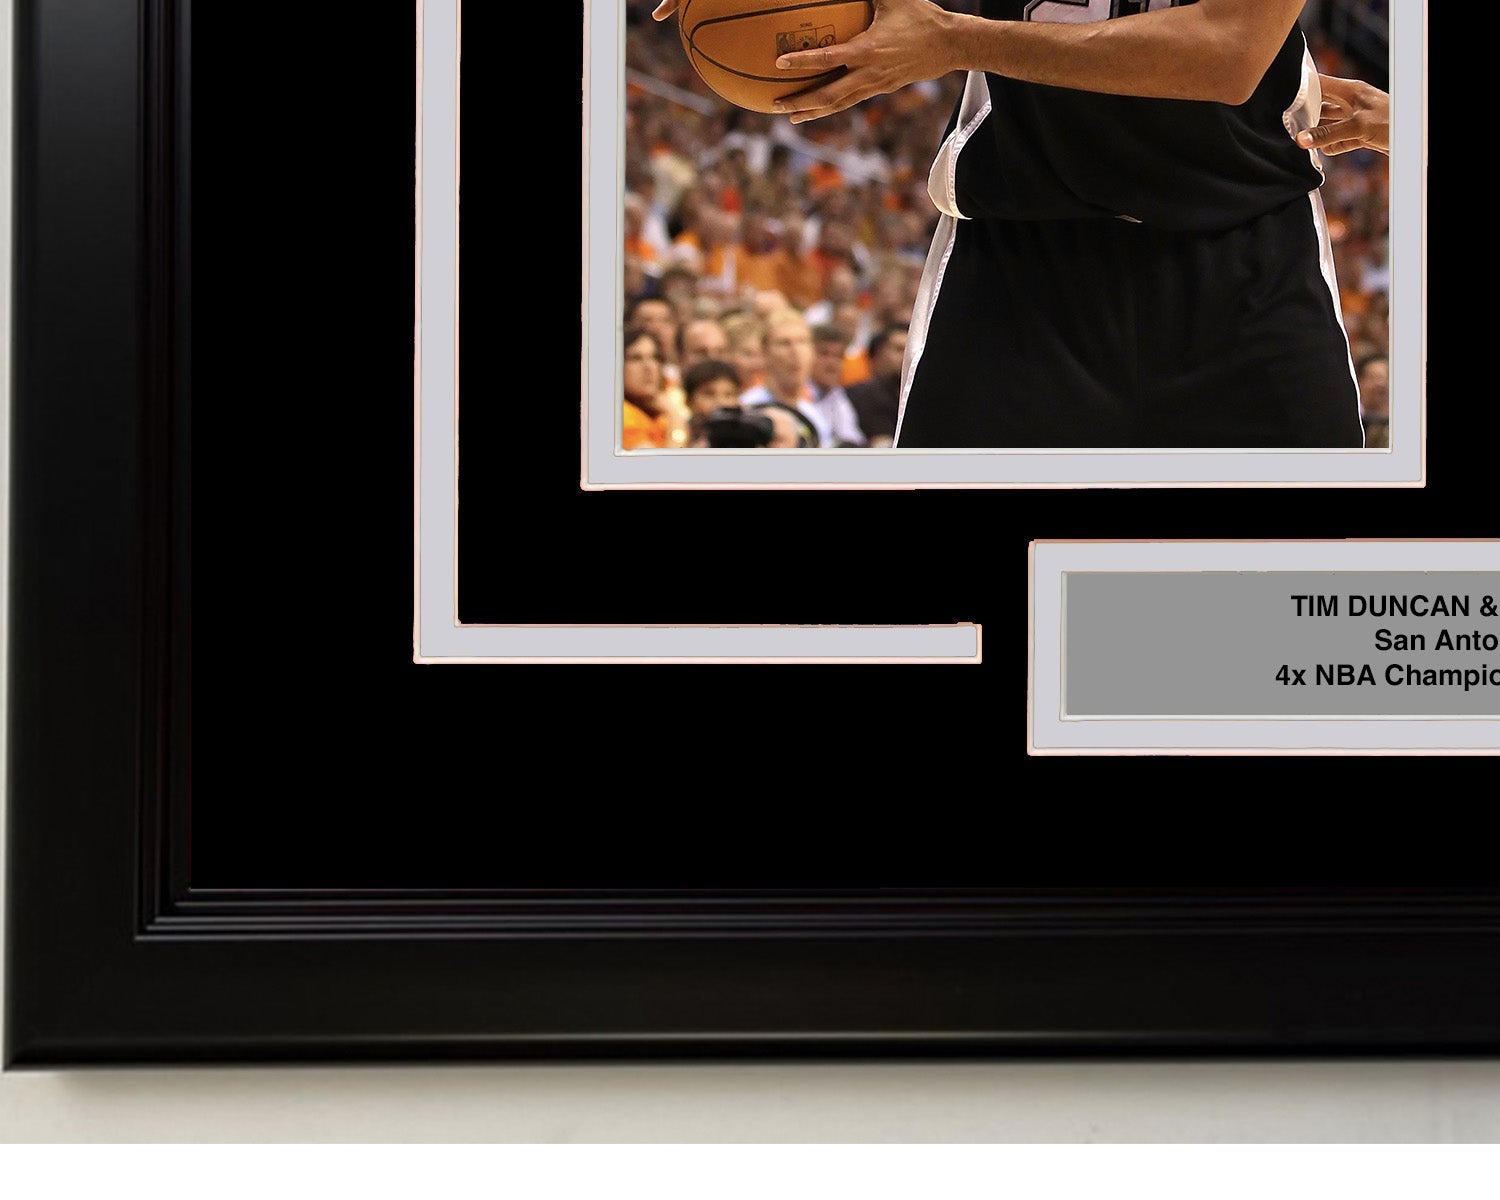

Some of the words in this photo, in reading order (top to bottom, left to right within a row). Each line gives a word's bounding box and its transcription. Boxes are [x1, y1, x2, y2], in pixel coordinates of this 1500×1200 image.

[1290, 594, 1338, 617] TIM
[1348, 594, 1470, 617] DUNCAN
[1479, 595, 1499, 618] &
[1374, 628, 1426, 651] San
[1275, 664, 1307, 686] 4x
[1315, 663, 1377, 686] NBA
